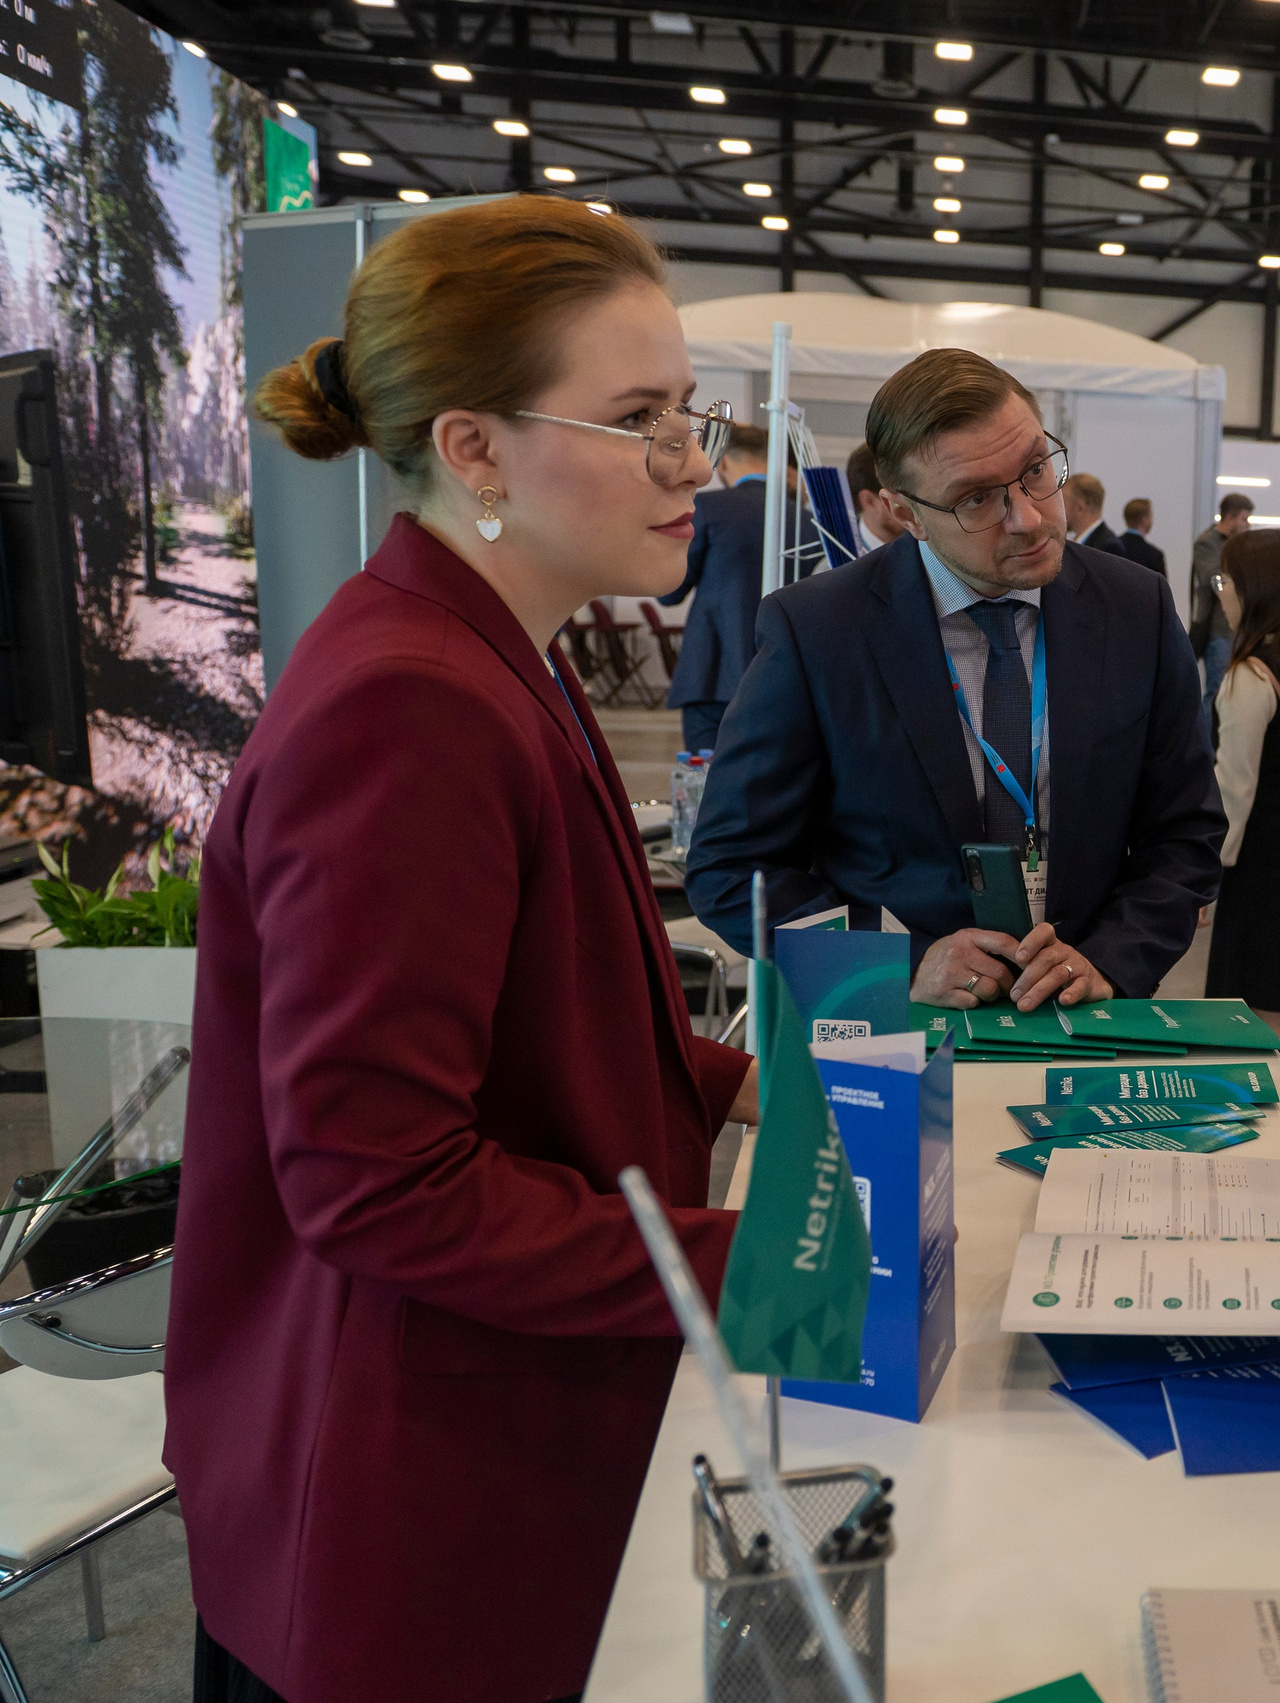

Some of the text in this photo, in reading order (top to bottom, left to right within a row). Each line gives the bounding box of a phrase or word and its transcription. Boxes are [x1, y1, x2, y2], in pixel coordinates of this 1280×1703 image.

[1118, 1073, 1132, 1099] Миграция
[1134, 1070, 1149, 1090] данных
[831, 1085, 879, 1100] ПРОЕКТНОЕ
[831, 1094, 884, 1110] УПРАВЛЕНИЕ
